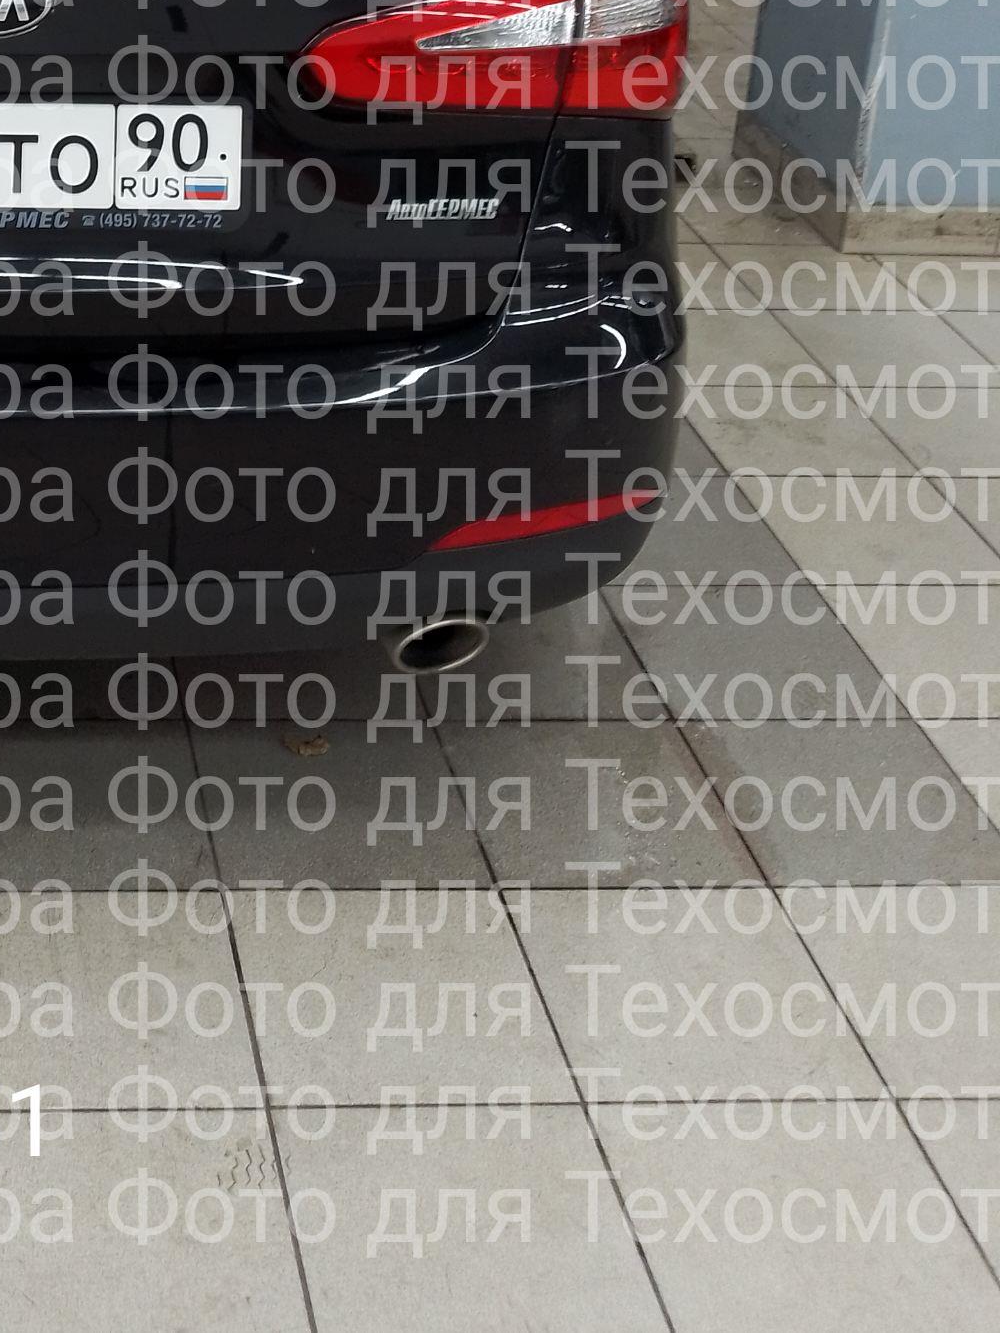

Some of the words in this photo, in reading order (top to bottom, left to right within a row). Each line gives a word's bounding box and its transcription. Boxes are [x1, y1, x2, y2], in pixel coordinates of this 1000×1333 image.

[128, 113, 208, 172] 90
[120, 177, 180, 198] RUS
[99, 213, 137, 228] (495)
[142, 213, 223, 228] 737-72-72
